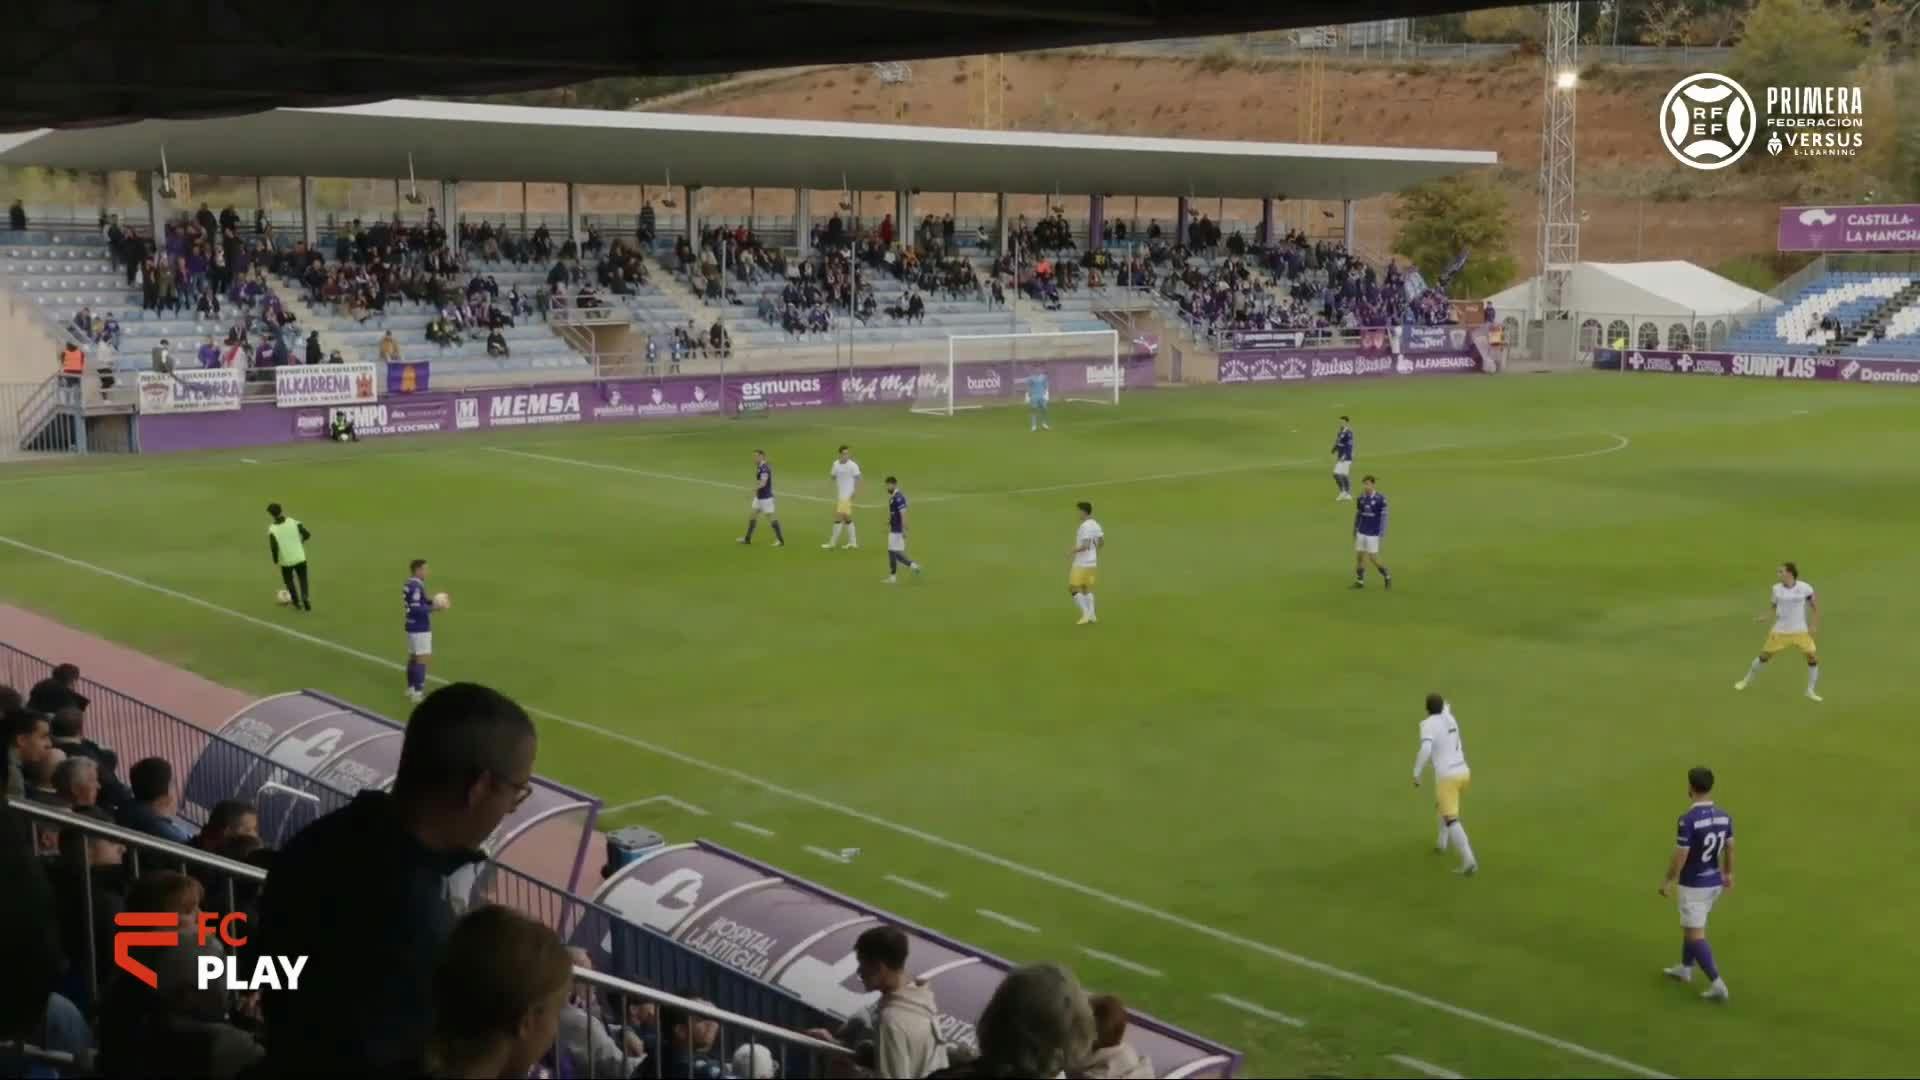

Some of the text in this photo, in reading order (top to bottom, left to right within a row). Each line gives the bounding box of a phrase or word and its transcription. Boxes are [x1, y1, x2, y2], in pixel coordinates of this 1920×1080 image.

[1847, 214, 1914, 226] CASTILLA-
[1846, 231, 1862, 242] LA
[1732, 355, 1816, 378] SUINPLAS
[278, 374, 352, 397] ALKARRENA
[742, 377, 821, 396] esmunas
[489, 391, 582, 417] MEMSA
[1701, 830, 1727, 863] 21
